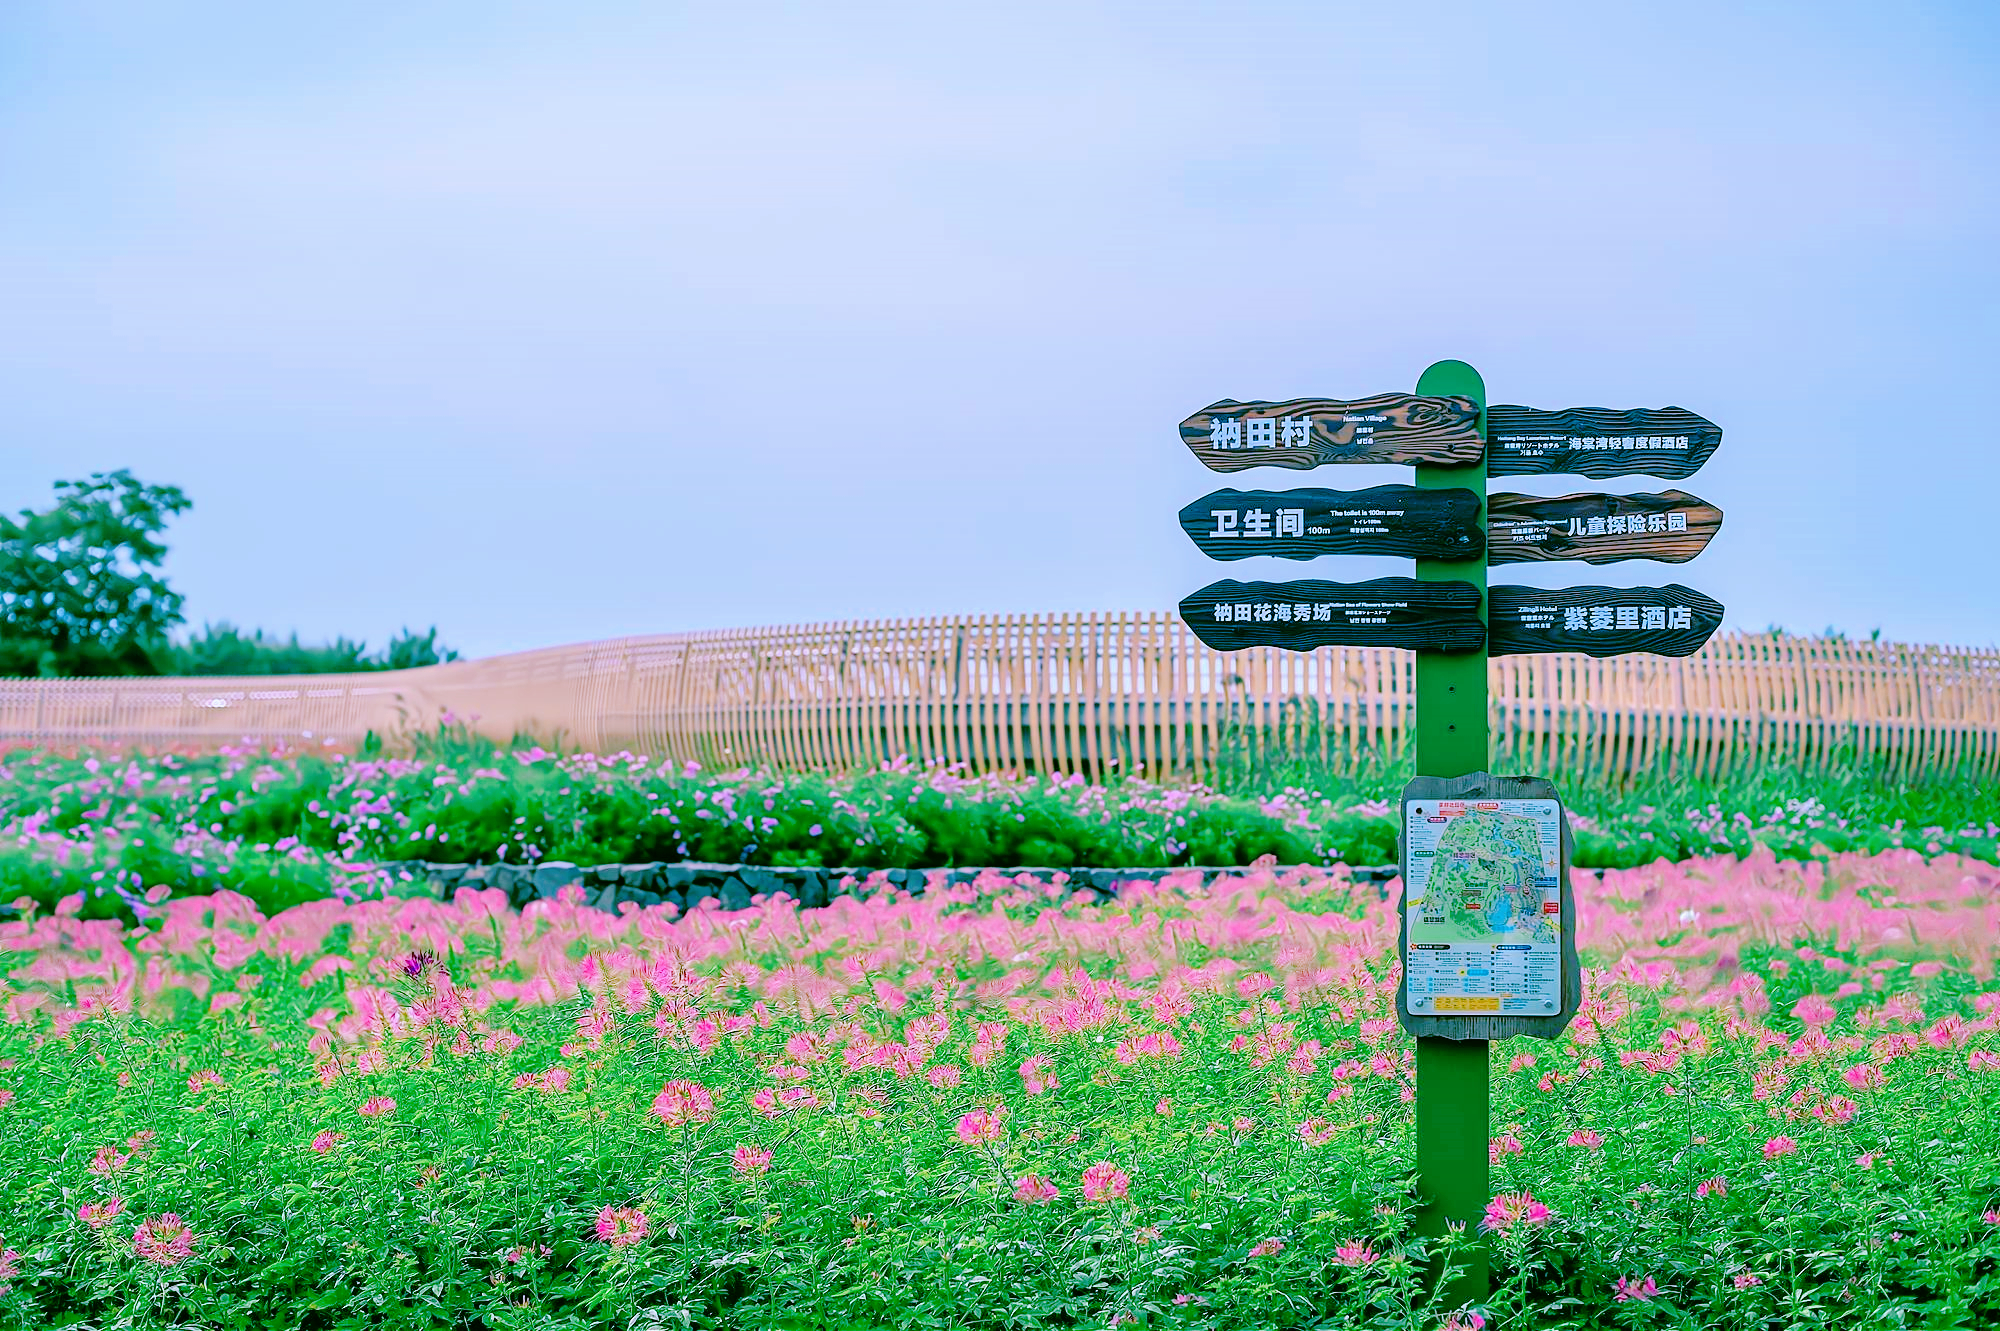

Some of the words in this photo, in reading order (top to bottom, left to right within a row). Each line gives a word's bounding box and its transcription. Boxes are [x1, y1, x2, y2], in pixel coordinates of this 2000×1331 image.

[1365, 415, 1387, 423] Village
[1210, 416, 1313, 450] 衲田村
[1569, 436, 1689, 450] 海棠湾轻奢度假酒店
[1209, 508, 1305, 538] 卫生间
[1307, 525, 1331, 535] 100m
[1329, 509, 1343, 517] The
[1344, 509, 1361, 517] toilet
[1567, 512, 1688, 537] 儿童探险乐园
[1213, 602, 1332, 622] 衲田花海秀场
[1563, 605, 1692, 631] 紫菱里酒店
